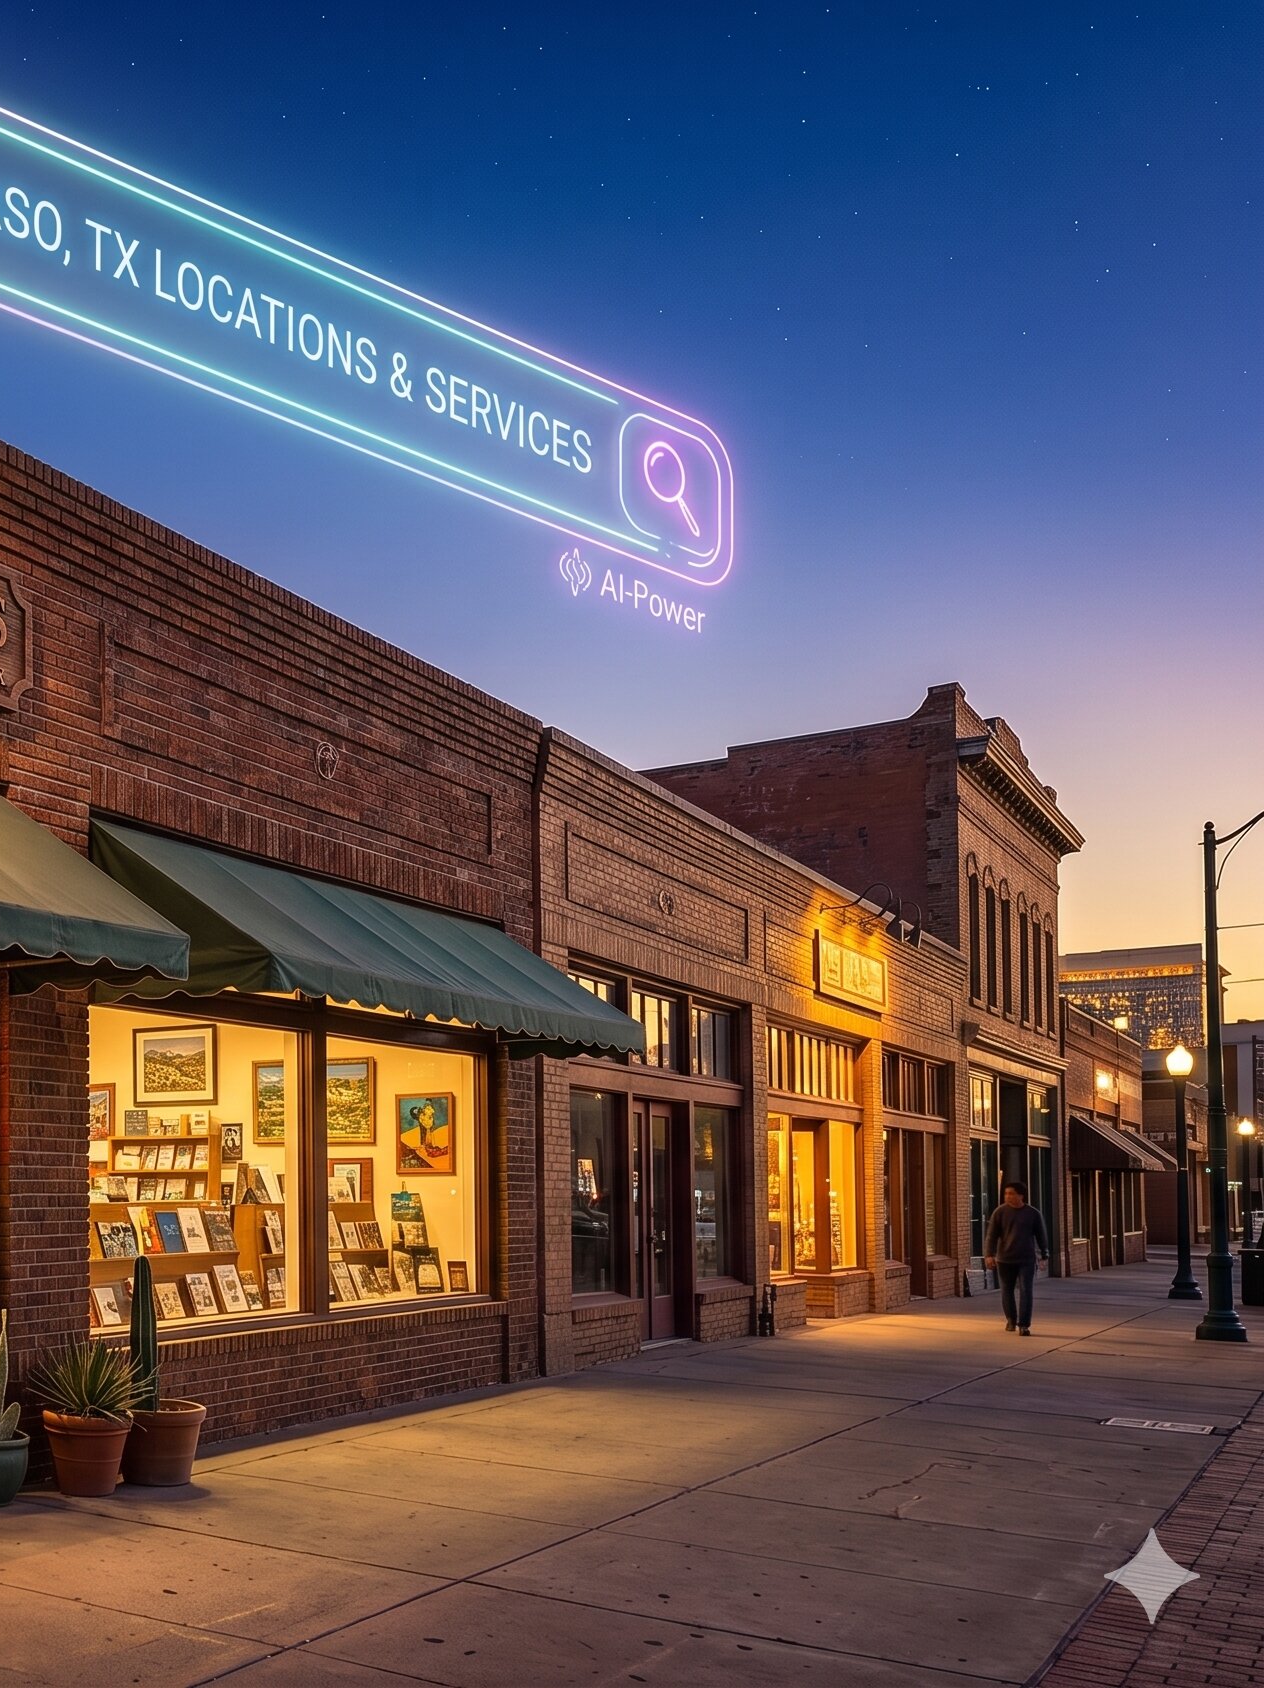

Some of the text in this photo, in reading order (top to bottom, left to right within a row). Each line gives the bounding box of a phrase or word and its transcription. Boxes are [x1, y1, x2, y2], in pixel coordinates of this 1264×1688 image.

[85, 218, 140, 289] TX
[155, 248, 377, 385] LOCATIONS
[389, 351, 414, 403] &
[425, 366, 593, 474] SERVICES
[600, 568, 706, 634] AI-Power
